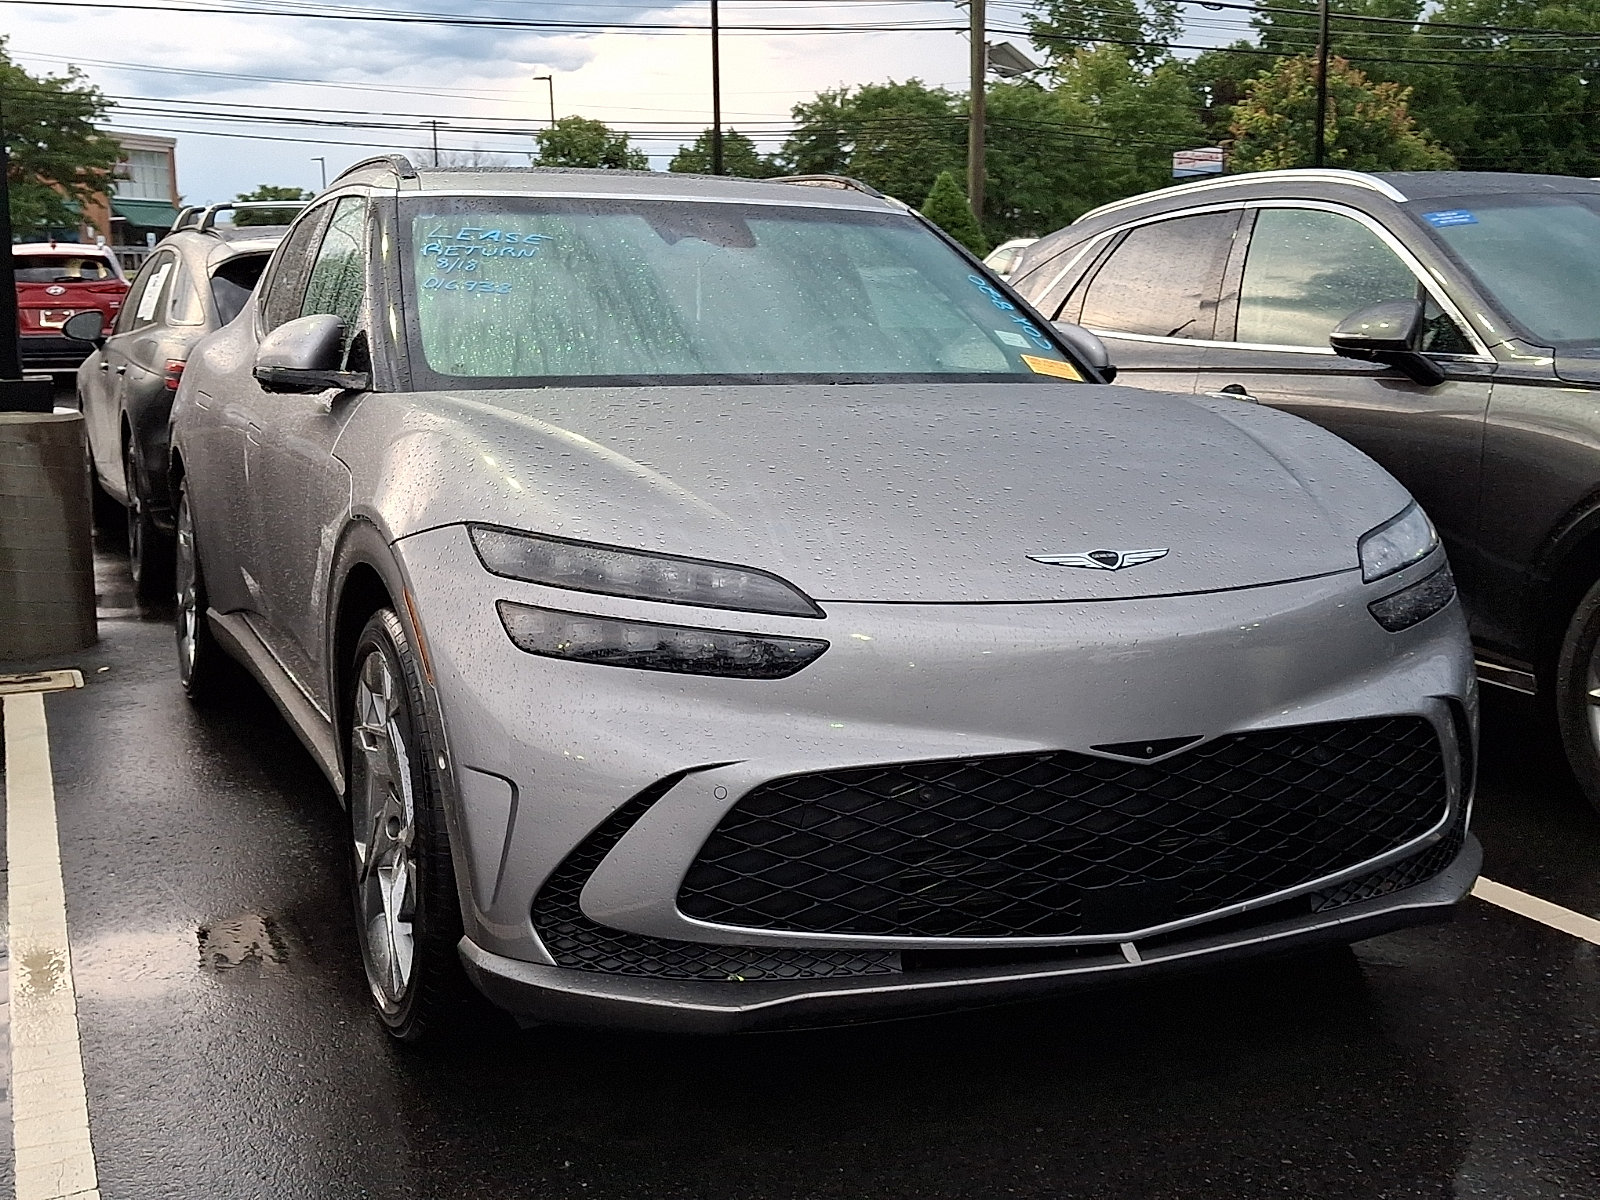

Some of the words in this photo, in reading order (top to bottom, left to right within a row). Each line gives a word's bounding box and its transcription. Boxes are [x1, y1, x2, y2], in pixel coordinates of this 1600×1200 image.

[427, 225, 553, 244] LEASE
[421, 242, 536, 258] RETURN
[436, 257, 479, 274] 8/18
